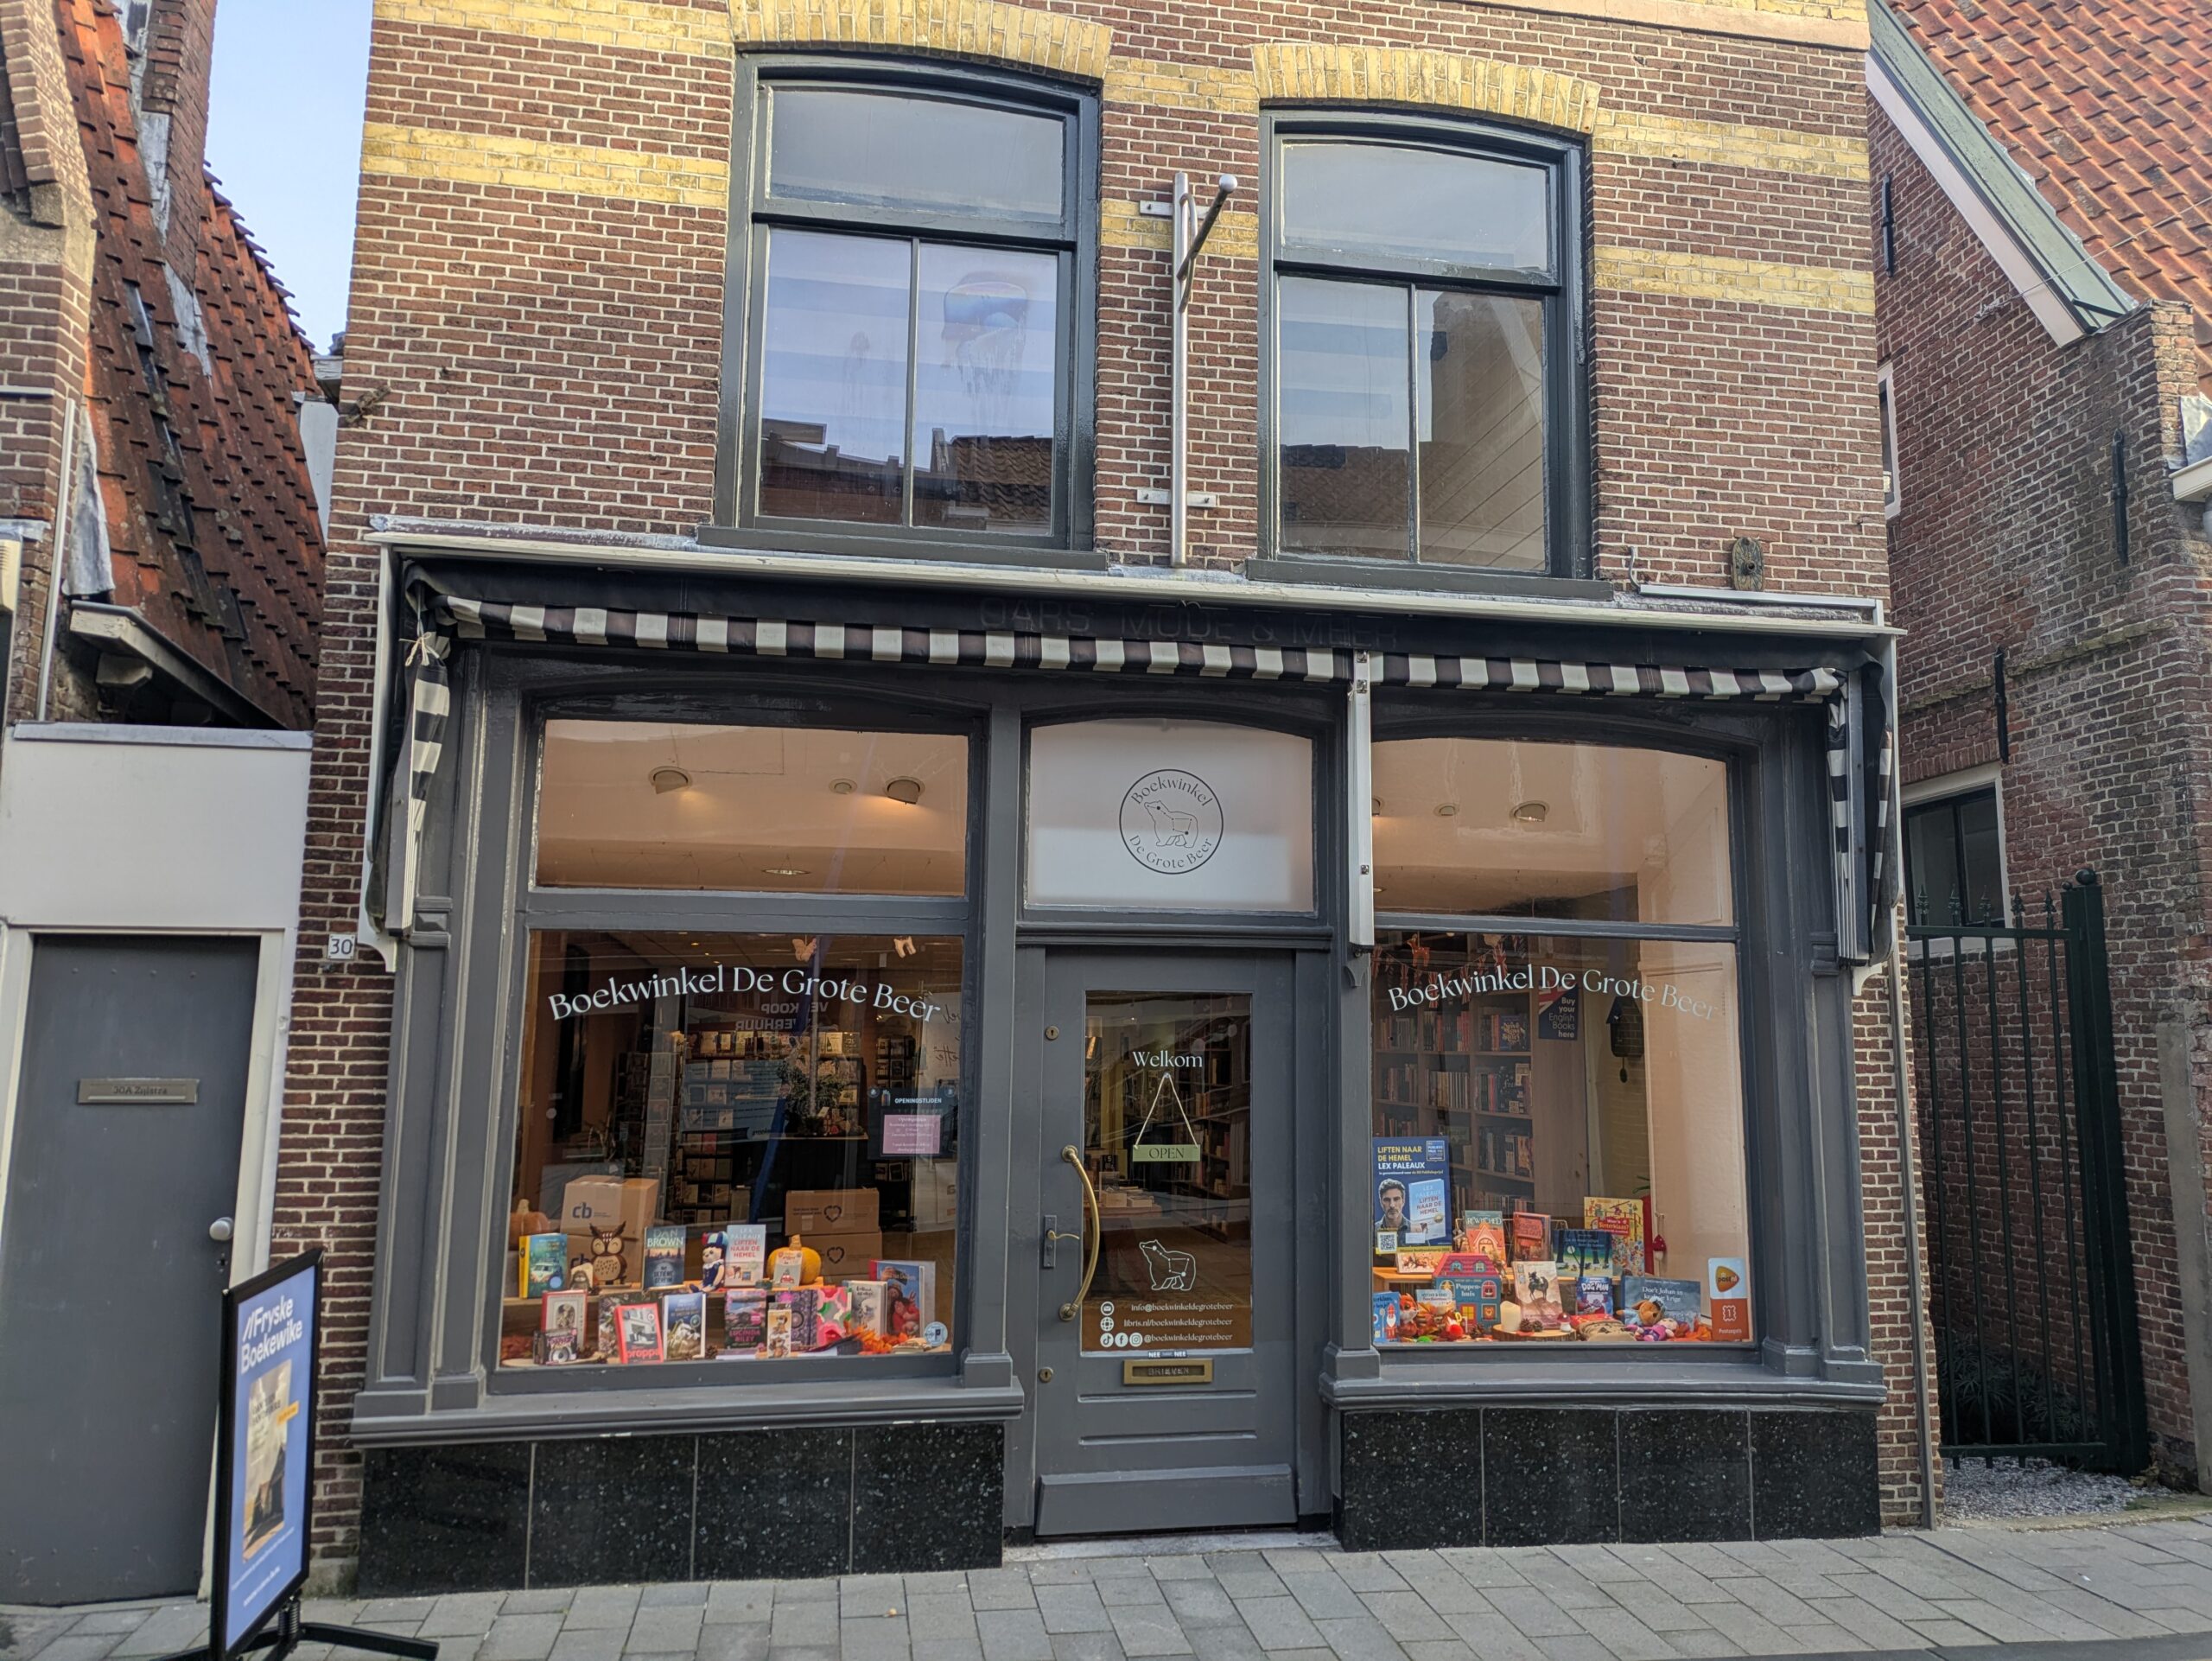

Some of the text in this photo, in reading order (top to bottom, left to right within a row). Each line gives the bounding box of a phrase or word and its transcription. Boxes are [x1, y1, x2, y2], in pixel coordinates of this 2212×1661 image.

[1130, 776, 1213, 806] Boekwinkel
[1129, 835, 1212, 868] De Grote Beer
[330, 939, 353, 955] 30
[548, 964, 942, 1022] Boekwinkel De Grote Beer
[1388, 964, 1718, 1021] Boekwinkel De Grote Beer
[1561, 997, 1575, 1006] Buy
[1548, 1013, 1575, 1022] English
[1552, 1021, 1576, 1030] Books
[1558, 1029, 1575, 1038] here
[1132, 1050, 1203, 1067] Welkom
[1148, 1147, 1185, 1159] OPEN
[572, 1202, 593, 1219] cb
[652, 1229, 678, 1238] DAN
[647, 1237, 683, 1247] BROWN
[1581, 1282, 1609, 1291] DOG MAN
[1131, 1303, 1234, 1313] info@boekwinkeldegrotebeer
[251, 1295, 294, 1339] Fryske
[1123, 1318, 1233, 1327] libris.nl/boekwinkeldegrotebeer
[1143, 1333, 1233, 1343] @boekwinkeldegrotebeer
[241, 1318, 302, 1375] Boekewike
[1147, 1366, 1190, 1376] BRIEVEN
